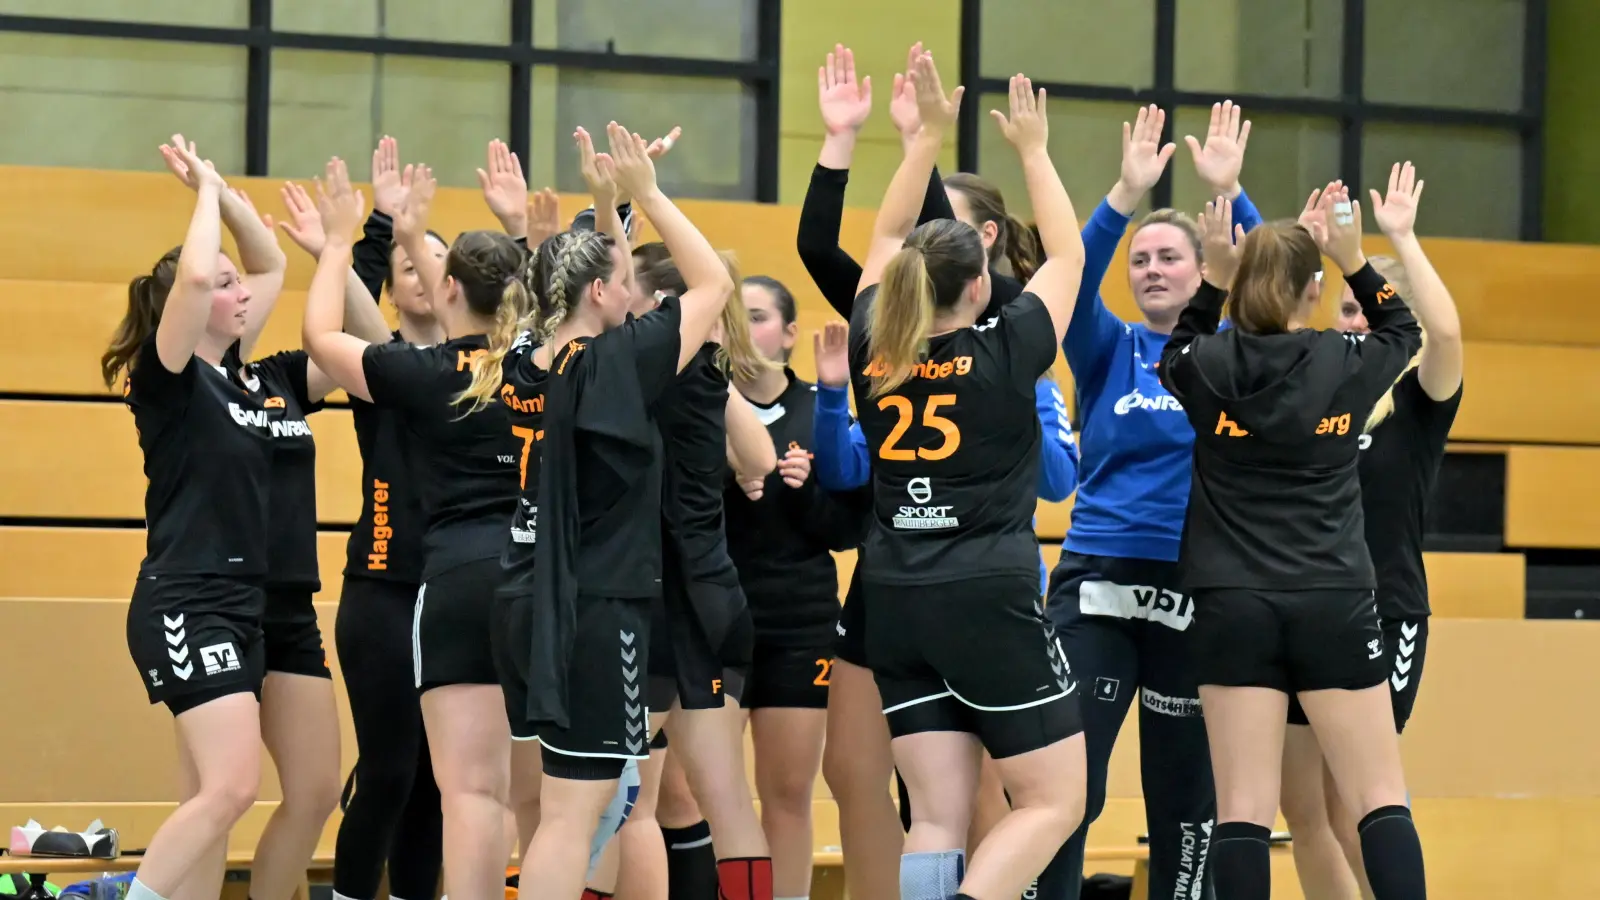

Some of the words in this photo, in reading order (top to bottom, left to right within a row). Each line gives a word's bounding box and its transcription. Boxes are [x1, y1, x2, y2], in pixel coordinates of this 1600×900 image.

[877, 393, 961, 461] 25
[367, 479, 393, 570] Hagerer
[895, 505, 954, 518] SPORT
[813, 658, 836, 686] 2
